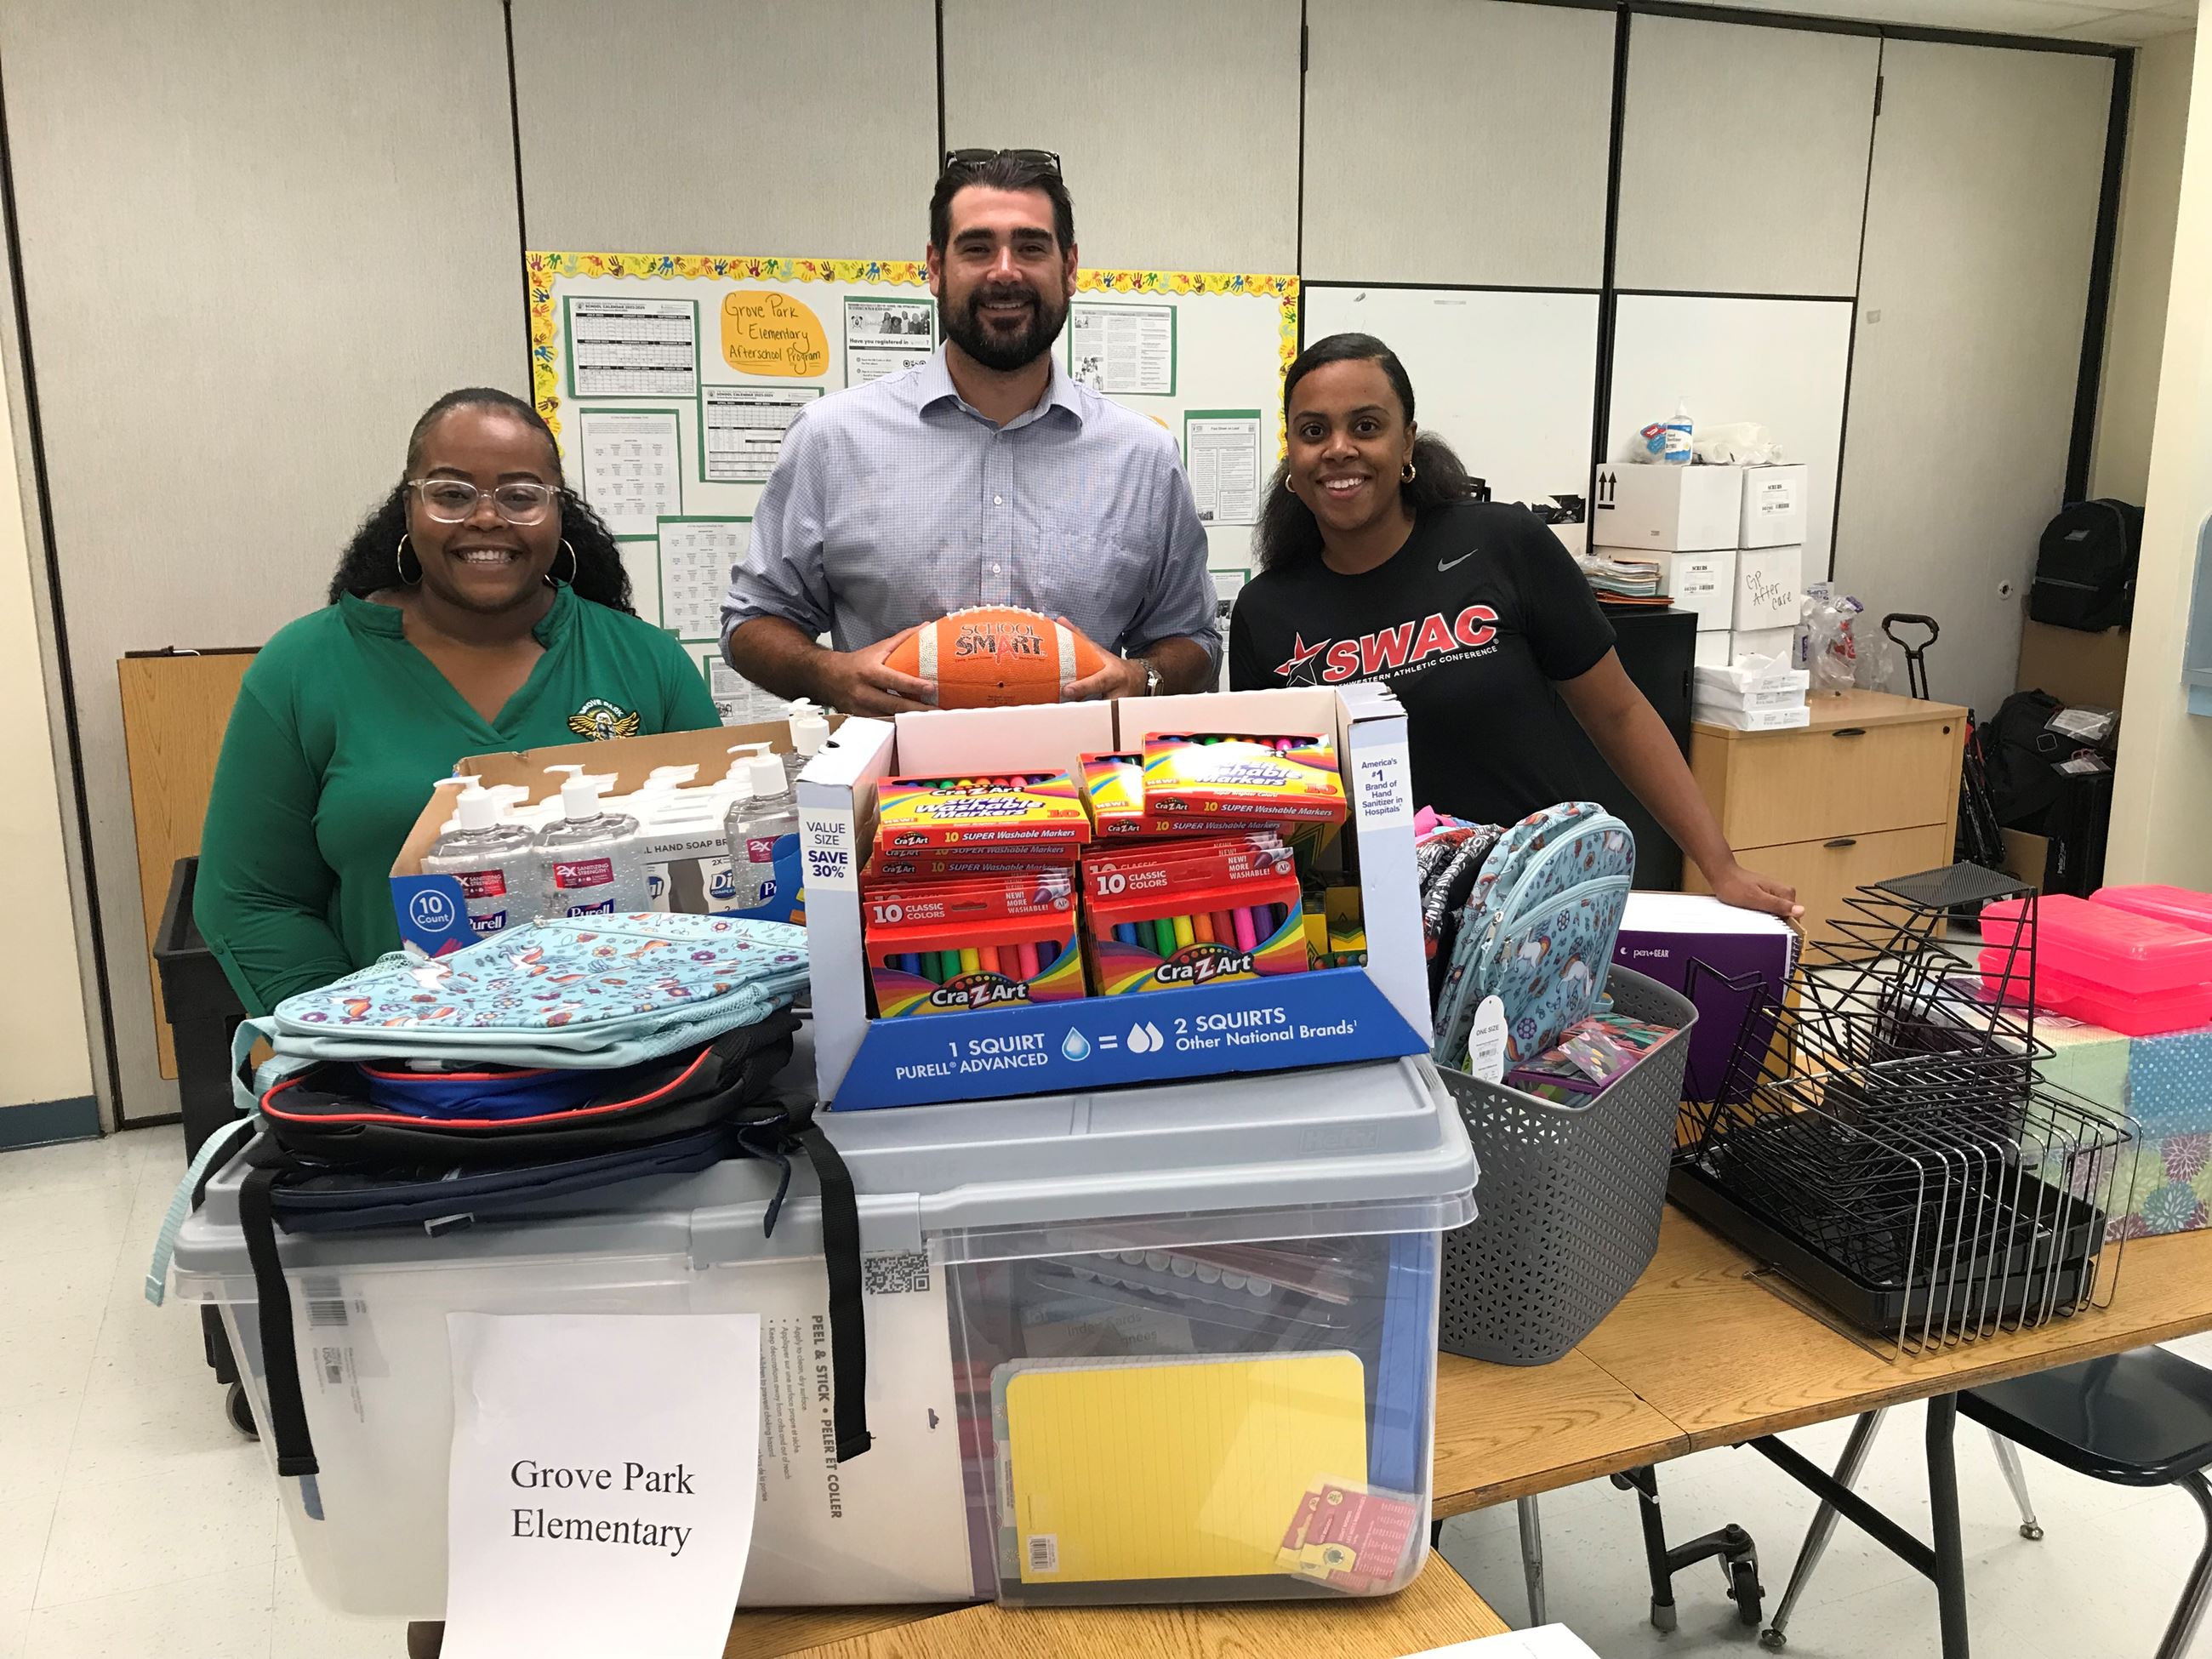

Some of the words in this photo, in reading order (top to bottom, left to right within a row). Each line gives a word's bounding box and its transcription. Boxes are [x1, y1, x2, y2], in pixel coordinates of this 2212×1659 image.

[725, 292, 765, 334] Grove
[765, 293, 799, 318] Park
[749, 323, 810, 355] Elementary
[729, 345, 782, 361] Afterschool
[787, 347, 821, 375] Program
[1746, 571, 1762, 590] GP
[1753, 583, 1781, 606] After
[961, 622, 1035, 636] SCHOOL
[955, 634, 1044, 665] SMART
[1322, 604, 1498, 681] SWAC
[1394, 659, 1437, 677] ATHLETIC
[1440, 646, 1498, 664] CONFERENCE
[603, 700, 624, 717] PARK
[1361, 758, 1398, 769] America's
[1365, 782, 1388, 791] Brand
[1371, 790, 1392, 798] Hand
[915, 800, 1045, 813] Washable
[1204, 801, 1217, 812] 10
[1221, 804, 1253, 812] SUPER
[1255, 805, 1297, 814] Washable
[1298, 807, 1333, 817] Markers
[1362, 798, 1394, 808] Sanitizer
[932, 809, 1026, 819] Markers
[1047, 809, 1080, 818] 10
[807, 822, 846, 834] VALUE
[1156, 821, 1170, 830] 10
[1172, 822, 1205, 830] SUPER
[1206, 821, 1246, 830] Washable
[1248, 821, 1280, 830] Markers
[814, 834, 840, 846] SIZE
[944, 832, 959, 843] 10
[962, 832, 995, 841] SUPER
[996, 830, 1040, 840] Washable
[1041, 829, 1075, 837] Markers
[654, 843, 683, 852] HAND
[686, 840, 713, 849] SOAP
[750, 841, 771, 852] 2X
[986, 846, 1029, 854] Washable
[1030, 845, 1064, 853] Markers
[808, 850, 848, 864] SAVE
[1228, 855, 1247, 864] NEW!
[556, 865, 578, 877] 2X
[931, 862, 945, 873] 10
[982, 863, 1024, 871] Washable
[1229, 863, 1249, 872] MORE
[1229, 868, 1270, 880] WASHABLE!
[711, 872, 734, 890] Di
[1096, 874, 1126, 896] 10
[1129, 870, 1166, 881] CLASSIC
[1129, 879, 1168, 890] COLORS
[419, 896, 442, 914] 10
[1006, 898, 1028, 907] MORE
[1007, 904, 1049, 914] WASHABLE!
[571, 904, 610, 917] Purell
[872, 904, 903, 924] 10
[905, 903, 944, 912] CLASSIC
[906, 910, 946, 921] COLORS
[417, 914, 450, 924] Count
[1633, 949, 1669, 959] pen+GEAR
[1175, 1018, 1188, 1035] 2
[1195, 1006, 1286, 1033] SQUIRTS
[1475, 1027, 1487, 1036] ONE
[1487, 1023, 1500, 1033] SIZE
[948, 1041, 958, 1058] 1
[968, 1032, 1046, 1057] SQUIRT
[1175, 1034, 1223, 1052] Other
[1226, 1027, 1293, 1046] National
[959, 1052, 1049, 1074] ADVANCED
[794, 1326, 803, 1344] Apply
[812, 1315, 824, 1345] PEEL
[781, 1327, 790, 1359] Appliquer
[814, 1349, 826, 1360] &
[770, 1346, 778, 1382] decorations
[797, 1376, 807, 1386] dry
[816, 1365, 830, 1402] STICK
[821, 1419, 835, 1453] PELER
[825, 1457, 837, 1470] ET
[510, 1460, 612, 1490] Grove
[622, 1462, 696, 1495] Park
[827, 1474, 842, 1519] COLLER
[511, 1508, 693, 1557] Elementary
